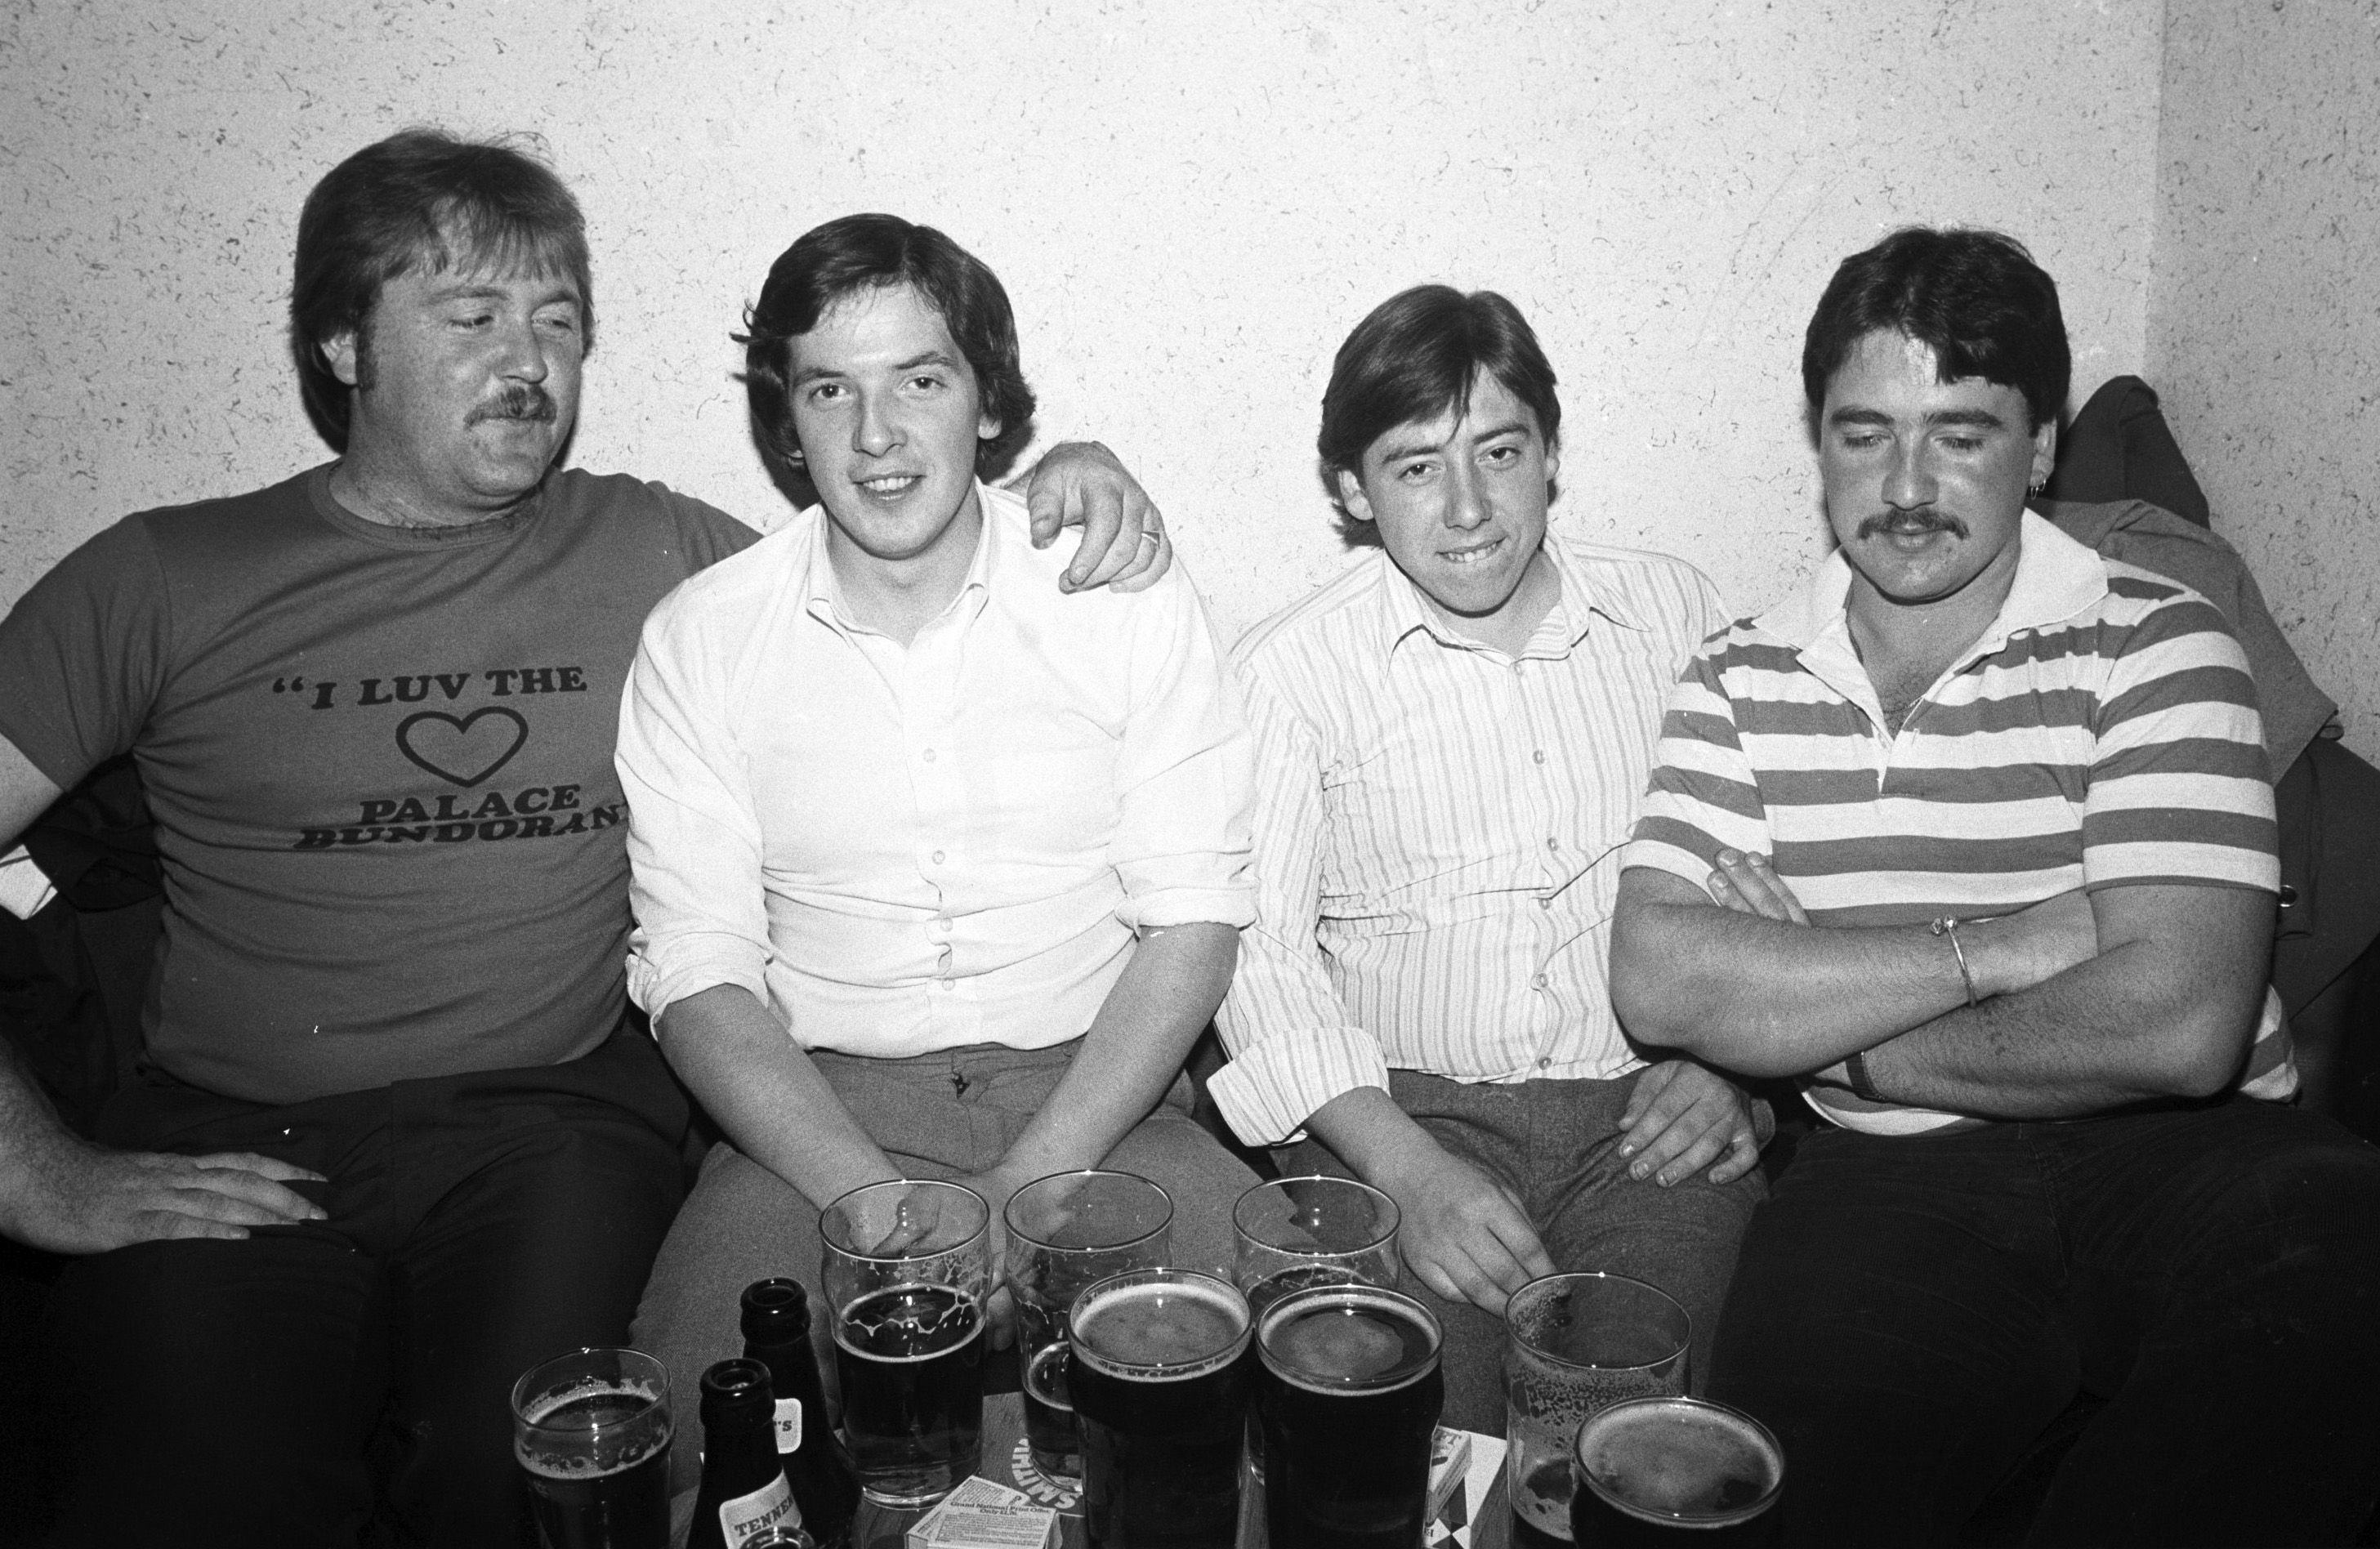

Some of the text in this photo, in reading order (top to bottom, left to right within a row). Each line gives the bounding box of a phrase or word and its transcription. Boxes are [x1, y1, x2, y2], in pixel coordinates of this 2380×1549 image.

[357, 672, 471, 706] LUV
[485, 666, 587, 696] THE
[355, 783, 581, 825] PALACE
[292, 804, 623, 850] BUNDORAN
[976, 1502, 1008, 1511] National
